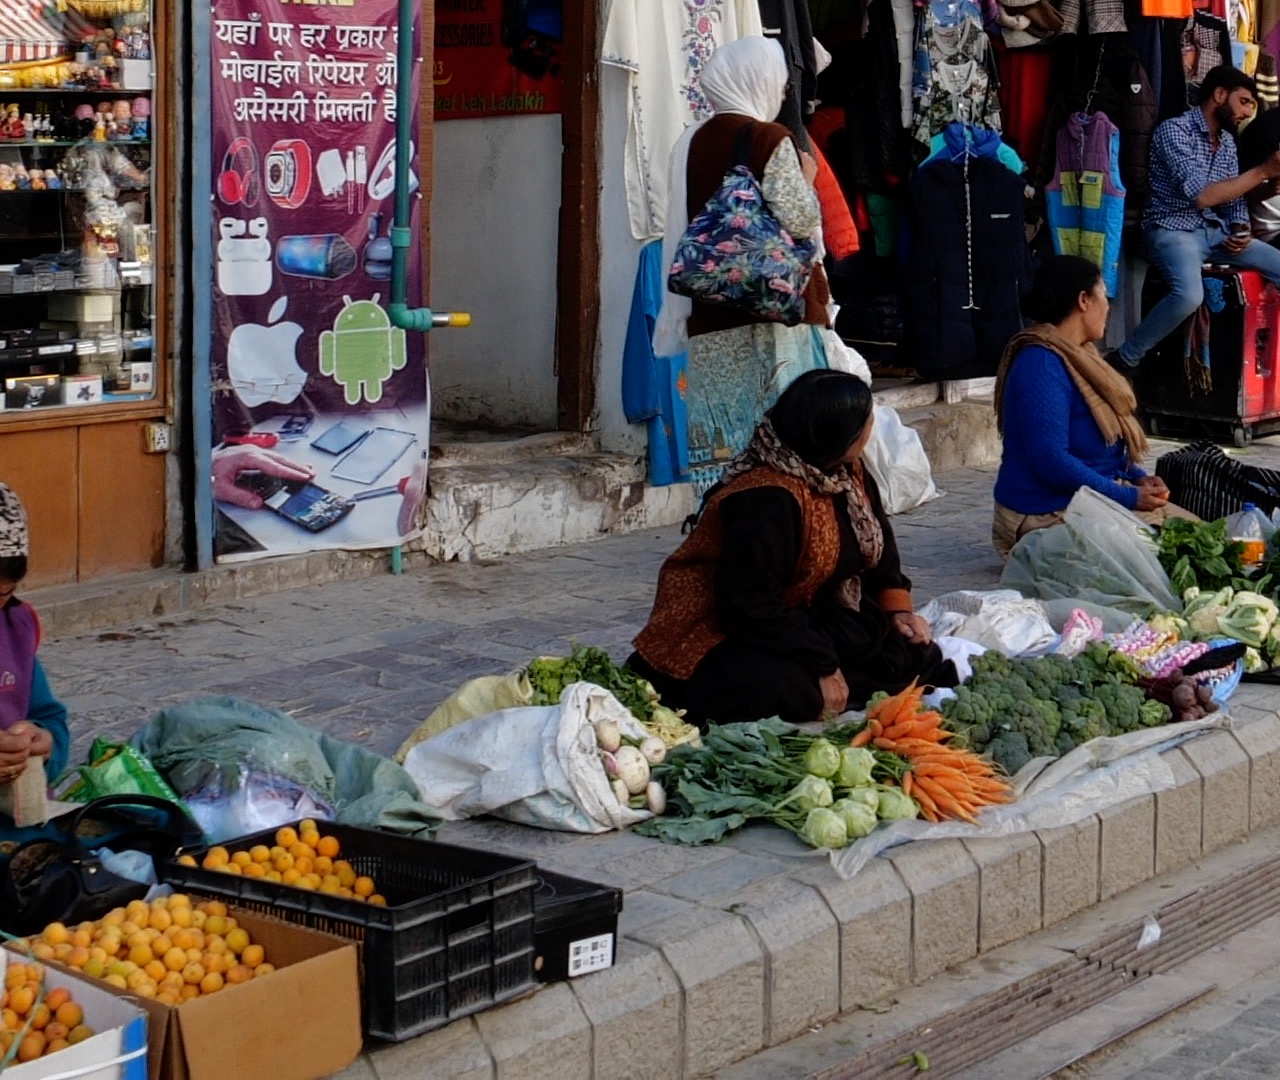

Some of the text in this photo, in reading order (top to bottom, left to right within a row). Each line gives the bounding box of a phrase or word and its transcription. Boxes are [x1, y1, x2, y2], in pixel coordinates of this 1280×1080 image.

[216, 11, 261, 47] यहाँ
[269, 25, 292, 48] पर
[300, 23, 326, 50] हर
[335, 25, 387, 50] प्रकार
[221, 50, 300, 86] मोबाईल
[307, 54, 367, 87] रिपेयर
[234, 87, 307, 122] असैसरी
[313, 90, 375, 122] मिलती
[461, 92, 485, 112] Leh
[491, 90, 545, 112] Ladakh
